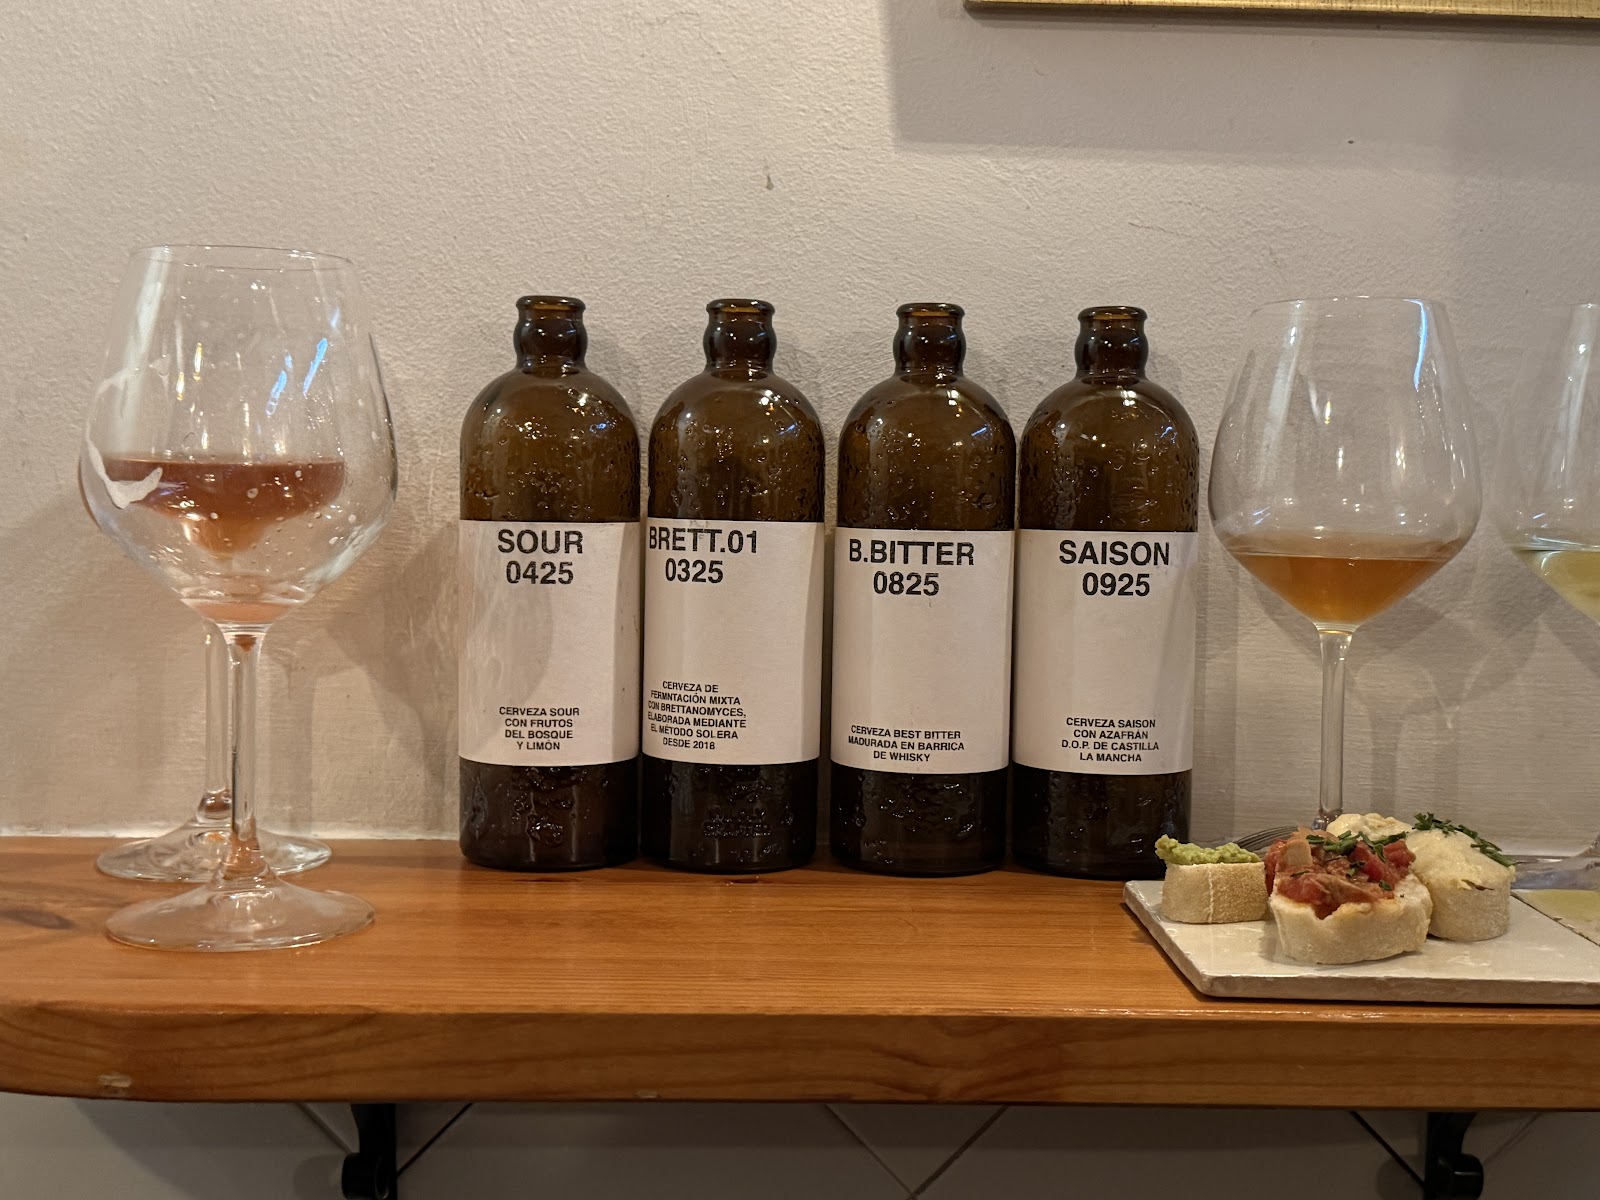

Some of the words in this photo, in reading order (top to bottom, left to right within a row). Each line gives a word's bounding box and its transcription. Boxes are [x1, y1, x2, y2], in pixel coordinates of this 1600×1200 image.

[498, 529, 583, 554] SOUR
[650, 526, 756, 553] BRETT.01
[850, 539, 974, 565] B.BITTER
[1059, 540, 1169, 566] SAISON
[506, 561, 573, 584] 0425
[666, 558, 723, 583] 0325
[874, 571, 939, 596] 0825
[1083, 573, 1149, 596] 0925
[662, 681, 702, 692] CERVEZA
[650, 690, 706, 703] FERMNTACIÓN
[710, 696, 740, 705] MIXTA
[500, 707, 547, 715] CERVEZA
[550, 708, 579, 716] SOUR
[648, 701, 659, 711] CON
[661, 703, 746, 718] BRETTANOMYCES,
[505, 719, 527, 727] CON
[531, 719, 572, 727] FRUTOS
[648, 711, 691, 725] ELABORADA
[693, 718, 746, 727] MEDIANTE
[1067, 718, 1115, 727] CERVEZA
[1118, 720, 1155, 728] SAISON
[505, 730, 525, 738] DEL
[651, 723, 657, 732] EL
[659, 725, 693, 737] MÉTODO
[697, 730, 738, 739] SOLERA
[851, 725, 891, 737] CERVEZA
[894, 730, 921, 738] BEST
[925, 731, 960, 739] BITTER
[1074, 730, 1096, 738] CON
[1099, 729, 1148, 739] AZAFRÁN
[527, 740, 559, 750] LIMÓN
[663, 737, 690, 748] DESDE
[849, 735, 897, 748] MADURADA
[918, 742, 964, 750] BARRICA
[1062, 740, 1089, 749] D.O.P.
[1094, 742, 1107, 750] DE
[1111, 742, 1159, 750] CASTILLA
[874, 751, 886, 759] DE
[890, 752, 930, 761] WHISKY
[1097, 753, 1141, 762] MANCHA
